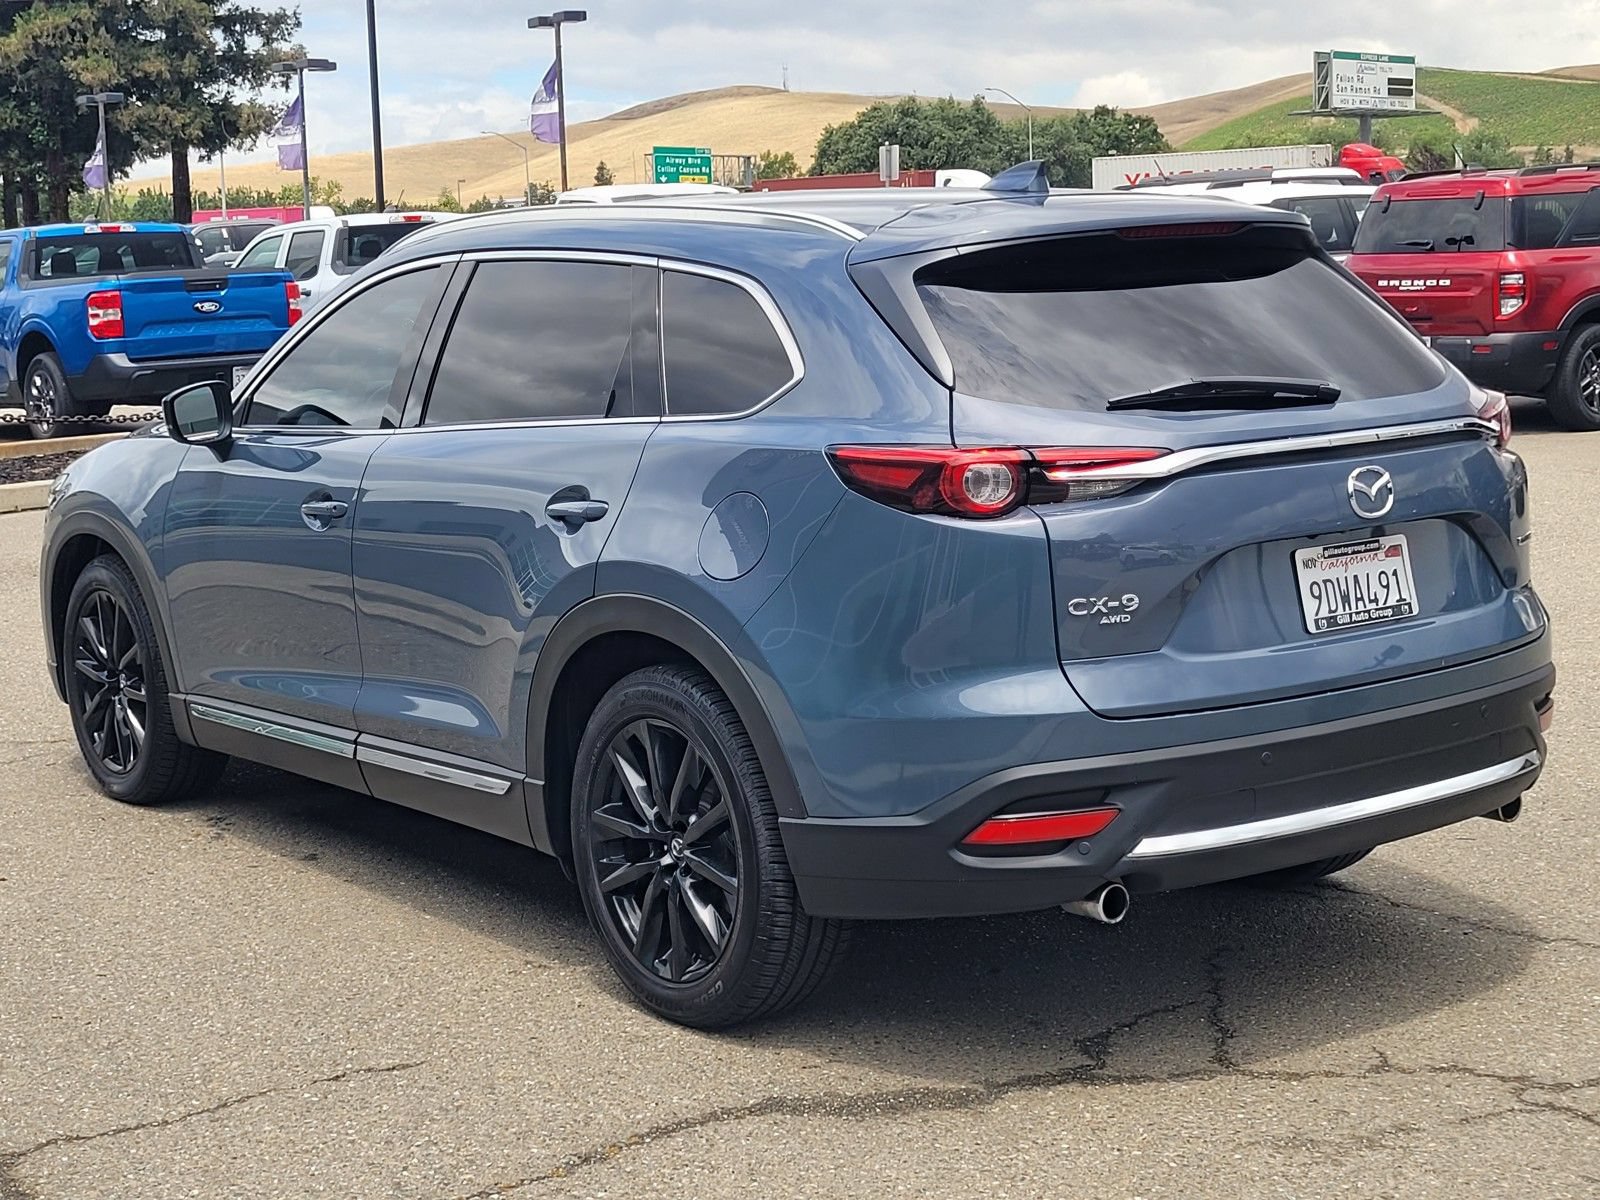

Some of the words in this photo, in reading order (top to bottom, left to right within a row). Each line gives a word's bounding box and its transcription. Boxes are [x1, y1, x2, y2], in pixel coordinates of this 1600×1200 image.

[1336, 74, 1354, 82] Fallon
[1357, 75, 1364, 83] Rd
[1336, 84, 1348, 92] San
[1350, 85, 1370, 94] Ramon
[1373, 86, 1381, 94] Rd
[665, 157, 685, 165] Airway
[679, 166, 700, 174] Canyon
[1323, 542, 1380, 557] gillautogroup.com
[1302, 557, 1317, 569] NOV
[1320, 552, 1380, 573] California
[1309, 568, 1407, 617] 9DWA491
[1068, 593, 1140, 615] CX-9
[1100, 614, 1131, 624] AWD
[1337, 613, 1351, 624] Gill
[1352, 611, 1369, 622] Auto
[1370, 608, 1393, 619] Group
